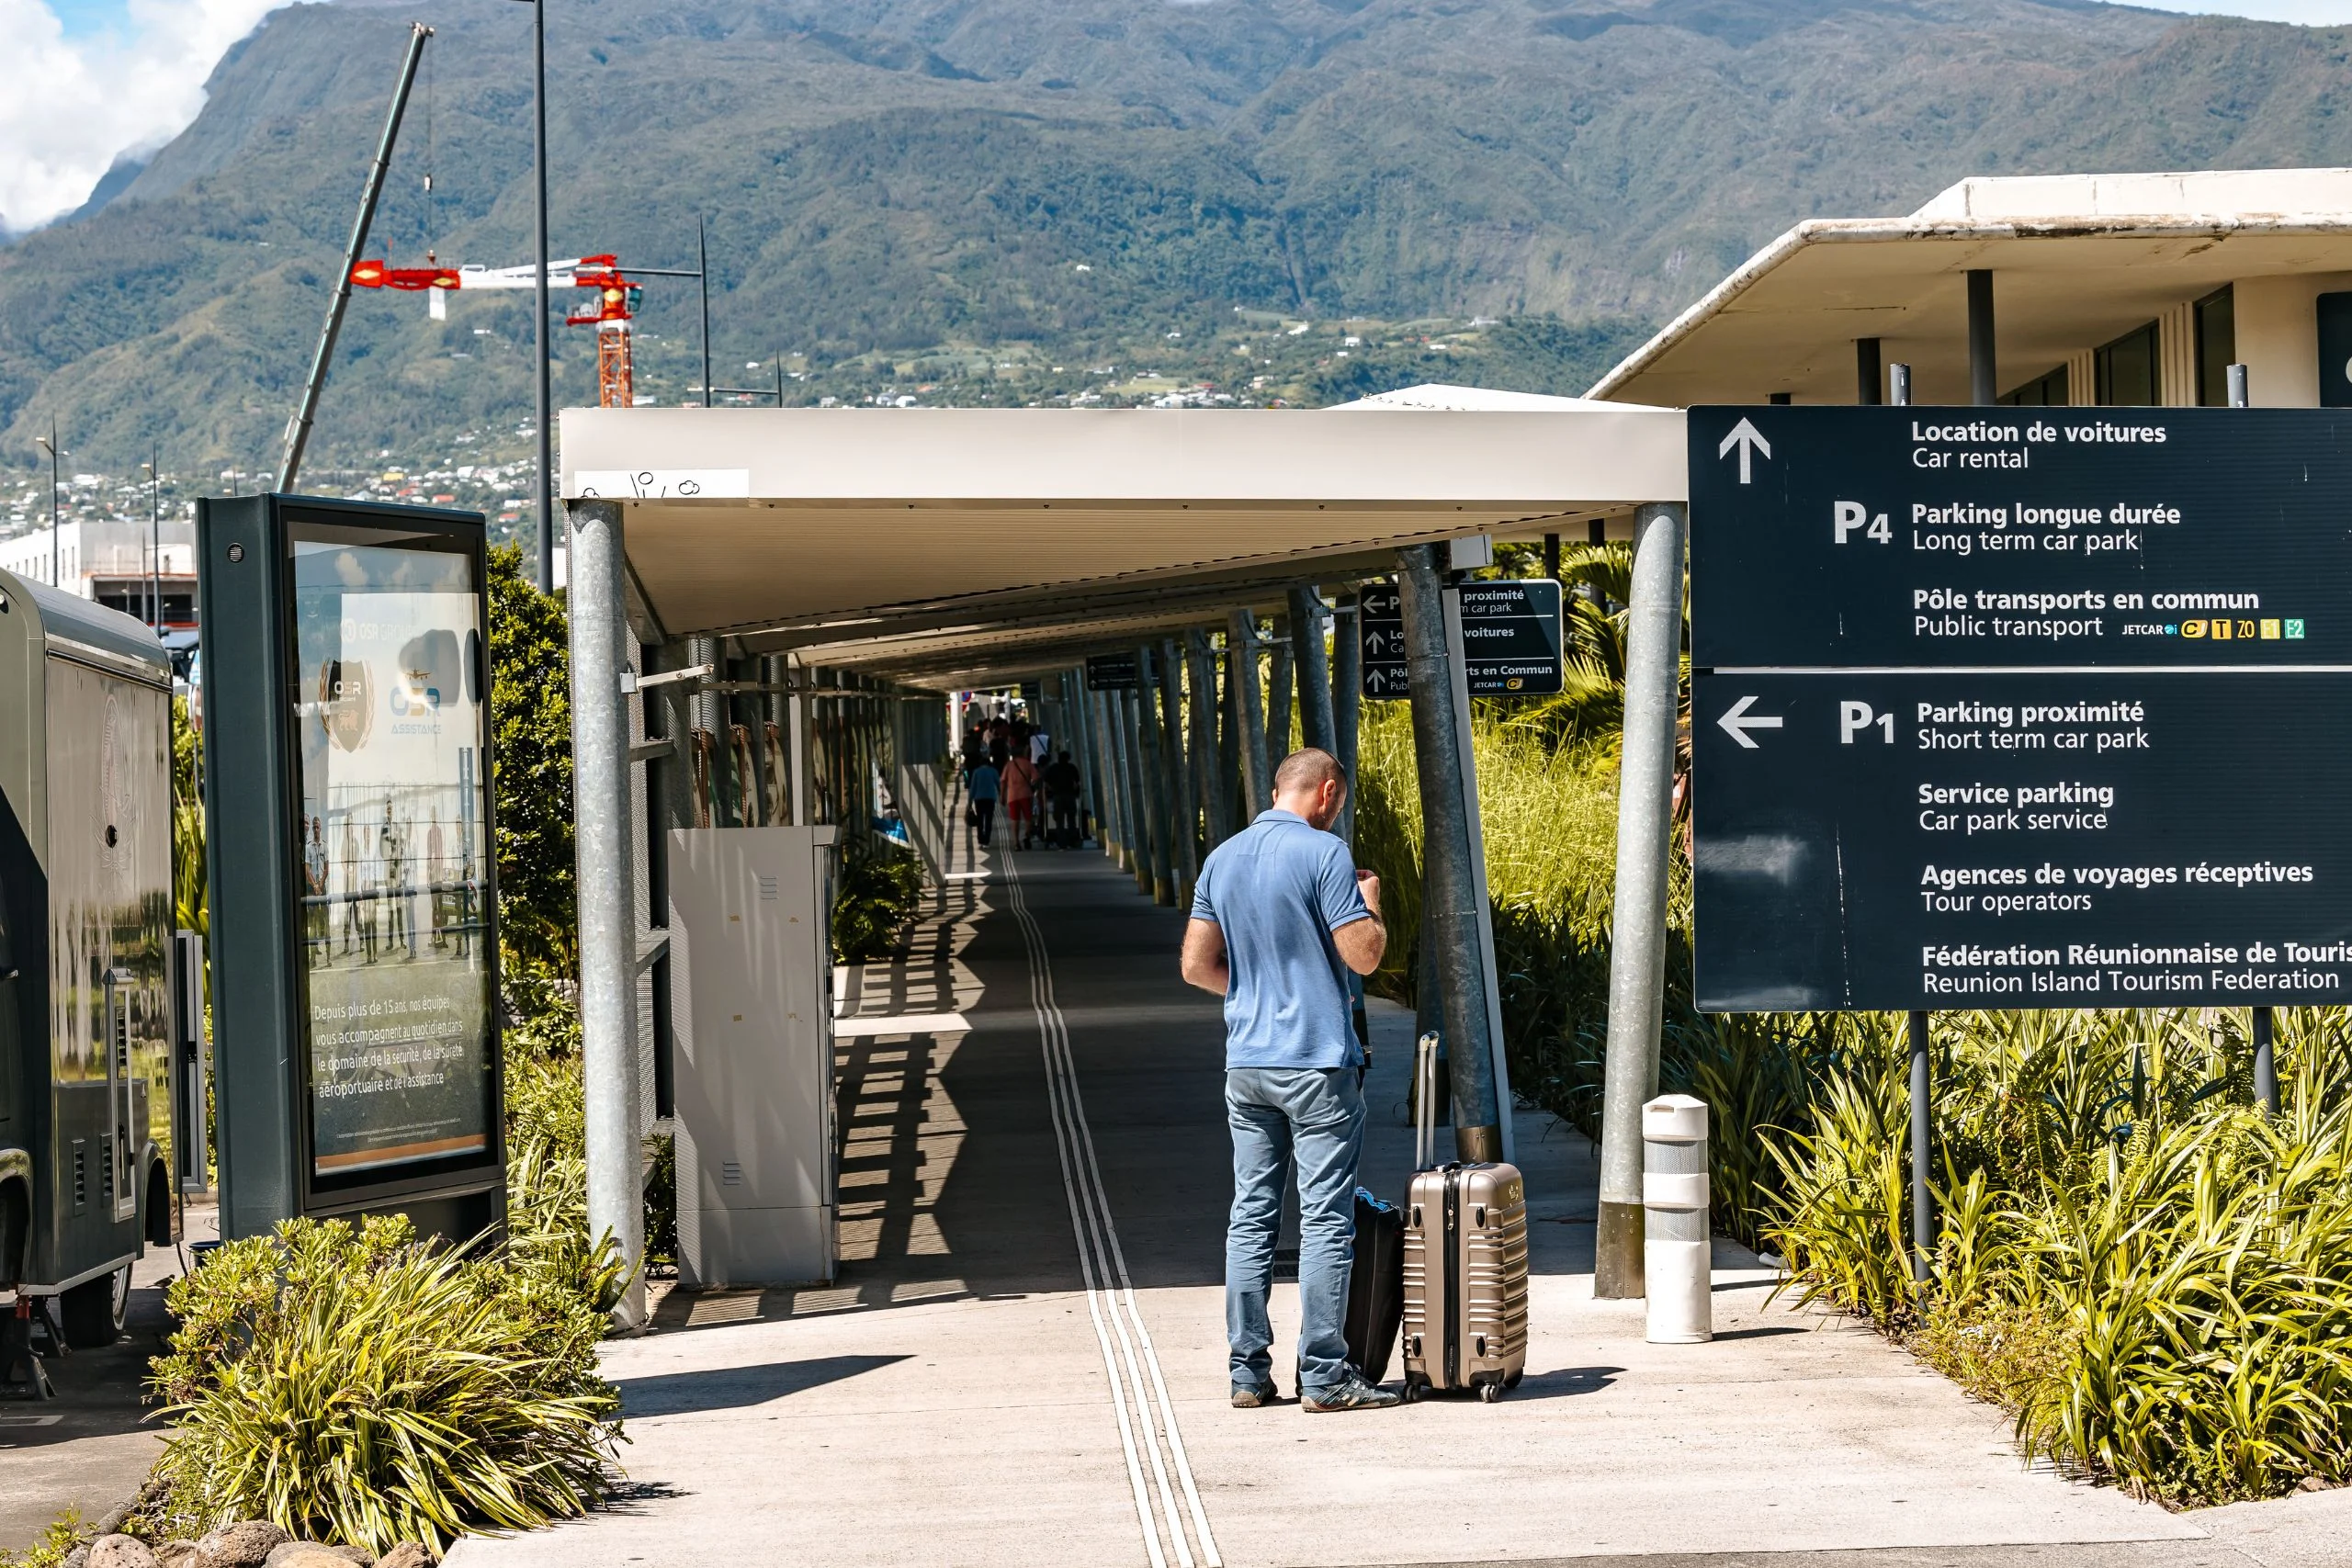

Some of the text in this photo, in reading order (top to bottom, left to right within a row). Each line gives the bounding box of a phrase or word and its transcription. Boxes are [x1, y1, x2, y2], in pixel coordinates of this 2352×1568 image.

[1913, 421, 2166, 442] Location de voitures
[1913, 447, 2028, 468] Car rental
[1835, 501, 1892, 544] P4
[1913, 502, 2180, 526] Parking longue durée
[1914, 529, 2139, 553] Long term car park
[1464, 590, 1524, 603] proximité
[1915, 588, 2258, 612] Pôle transports en commun
[1471, 604, 1487, 613] car
[1489, 603, 1512, 615] park
[1464, 627, 1514, 638] voitures
[1916, 615, 2103, 637] Public transport
[2215, 620, 2230, 638] T
[2262, 620, 2278, 638] E1
[2287, 620, 2302, 638] E2
[1500, 666, 1553, 675] Commun
[334, 681, 361, 695] OSR
[390, 687, 441, 716] OSR
[1841, 701, 1894, 743] P1
[1918, 701, 2143, 728] Parking proximité
[390, 723, 441, 735] ASSISTANCE
[1918, 727, 2150, 750] Short term car park
[1919, 782, 2113, 807] Service parking
[1920, 808, 2108, 833] Car park service
[1921, 862, 2312, 889] Agences de voyages réceptives
[1921, 891, 2091, 916] Tour operators
[1923, 944, 2060, 966] Fédération
[2069, 942, 2238, 964] Réunionnaise
[2246, 942, 2277, 963] de
[1924, 968, 2338, 993] Reunion Island Tourism Federation
[314, 995, 450, 1021] Depuis plus de 15 ans, nos équipes
[315, 1018, 463, 1046] vous accompagnent au quotidien dans
[317, 1057, 326, 1072] le
[328, 1053, 368, 1071] domaine
[370, 1051, 382, 1066] de
[383, 1049, 390, 1065] la
[392, 1045, 423, 1064] sécurité,
[423, 1045, 432, 1060] de
[434, 1044, 440, 1058] la
[385, 1076, 393, 1090] et
[393, 1077, 402, 1090] de
[403, 1070, 444, 1089] l'assistance
